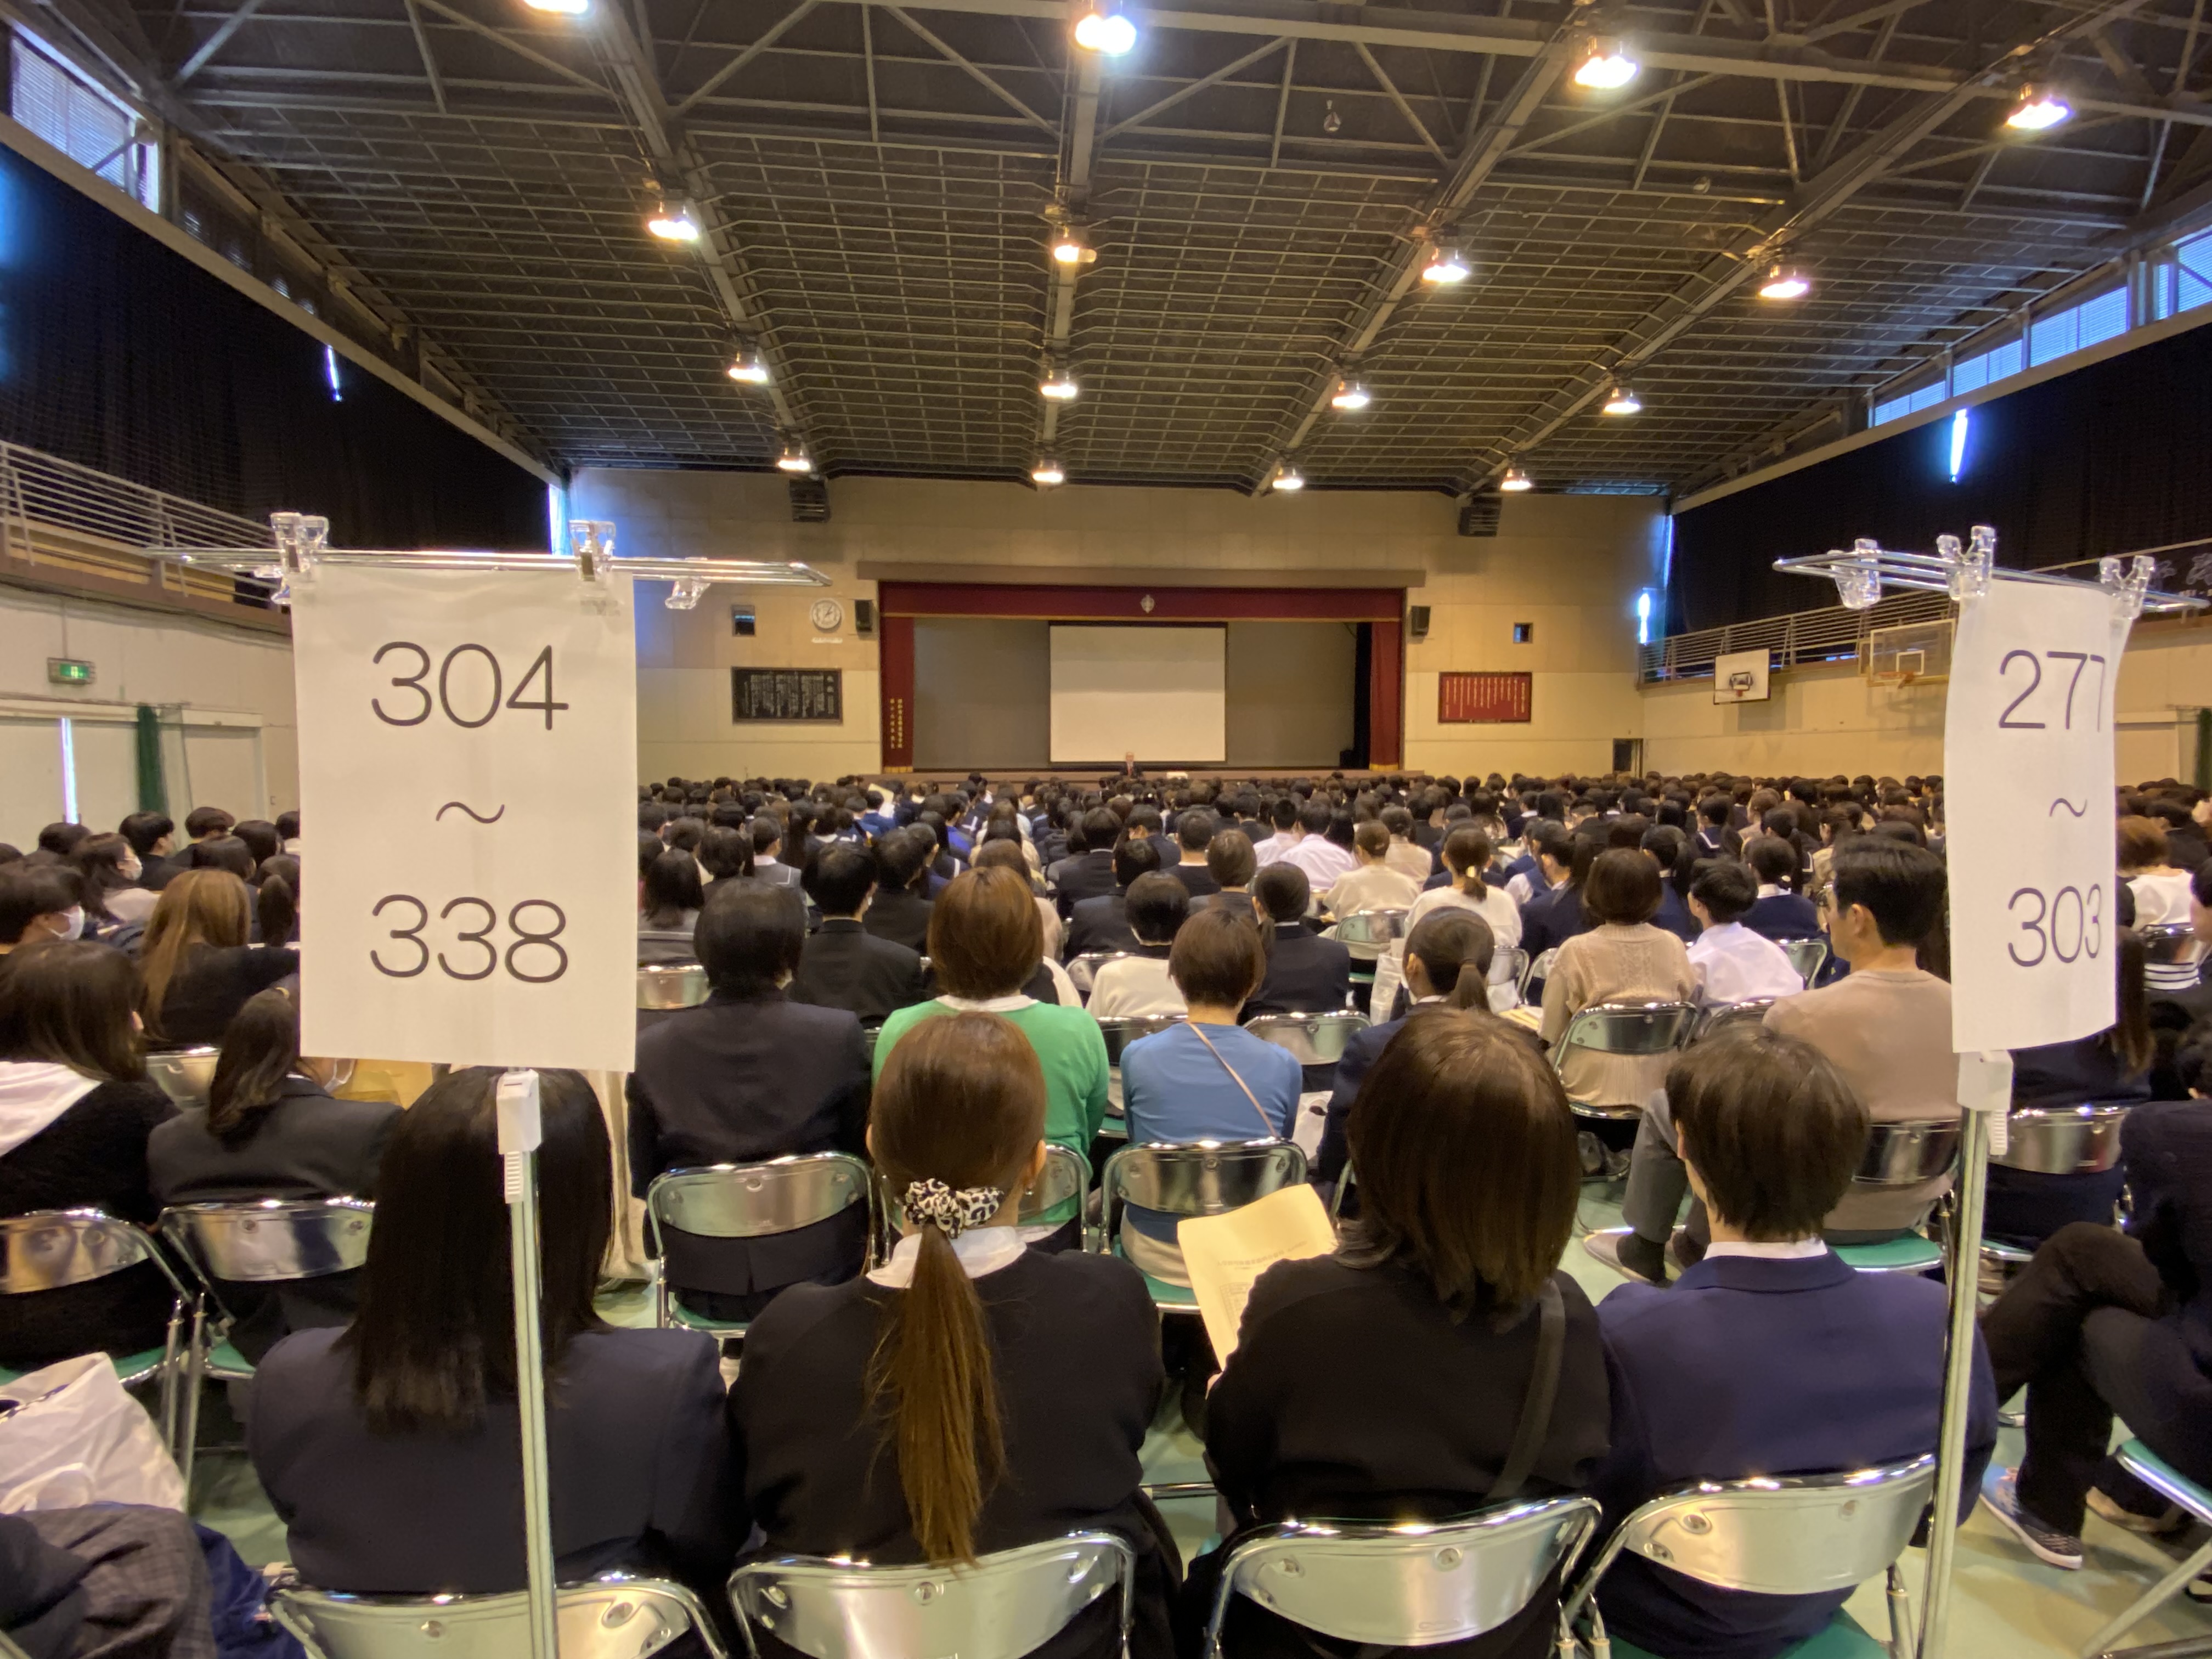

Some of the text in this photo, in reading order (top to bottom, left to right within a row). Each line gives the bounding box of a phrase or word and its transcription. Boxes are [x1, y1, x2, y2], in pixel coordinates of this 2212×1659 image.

[370, 640, 571, 732] 304
[1997, 649, 2106, 732] 277
[368, 893, 570, 984] 338
[2007, 883, 2102, 968] 303
